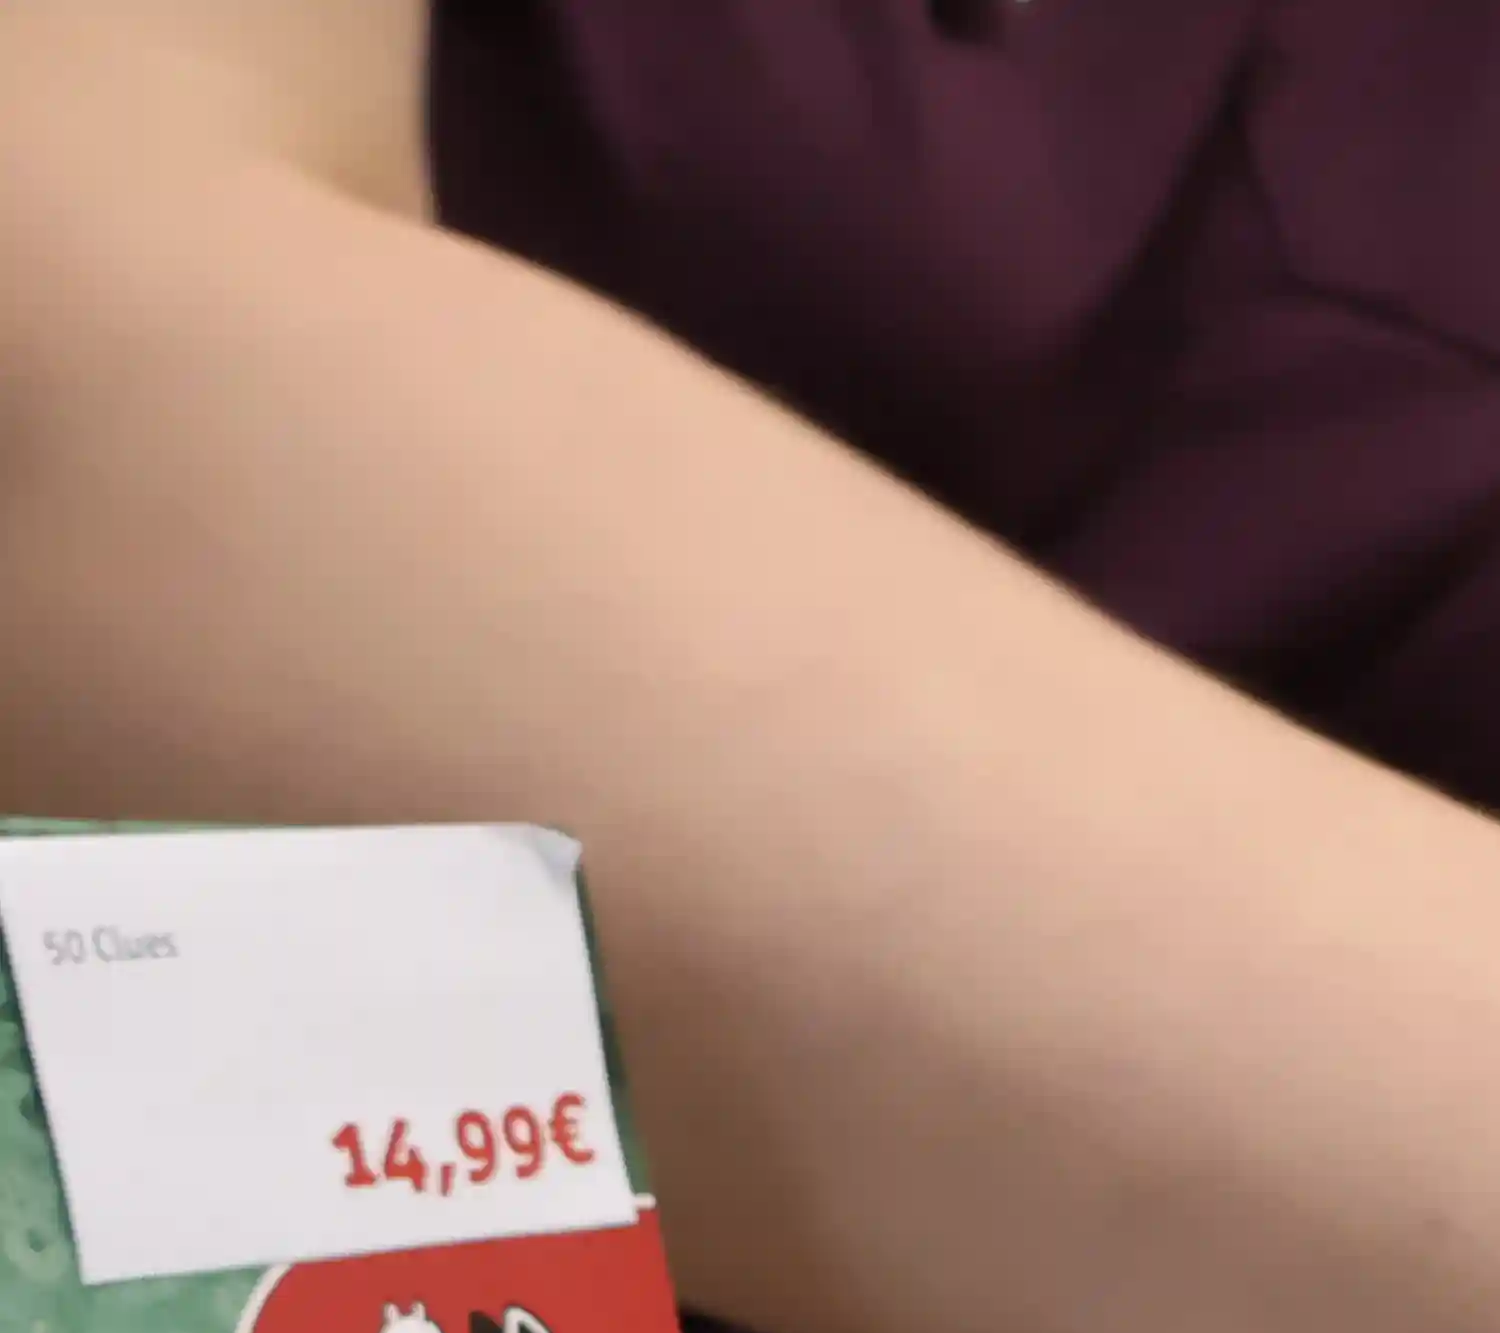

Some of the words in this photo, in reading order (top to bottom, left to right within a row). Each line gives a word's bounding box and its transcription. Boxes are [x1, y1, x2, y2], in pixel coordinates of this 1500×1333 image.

[42, 928, 86, 965] 50
[92, 926, 179, 964] Clues
[332, 1092, 597, 1196] 14,99€
